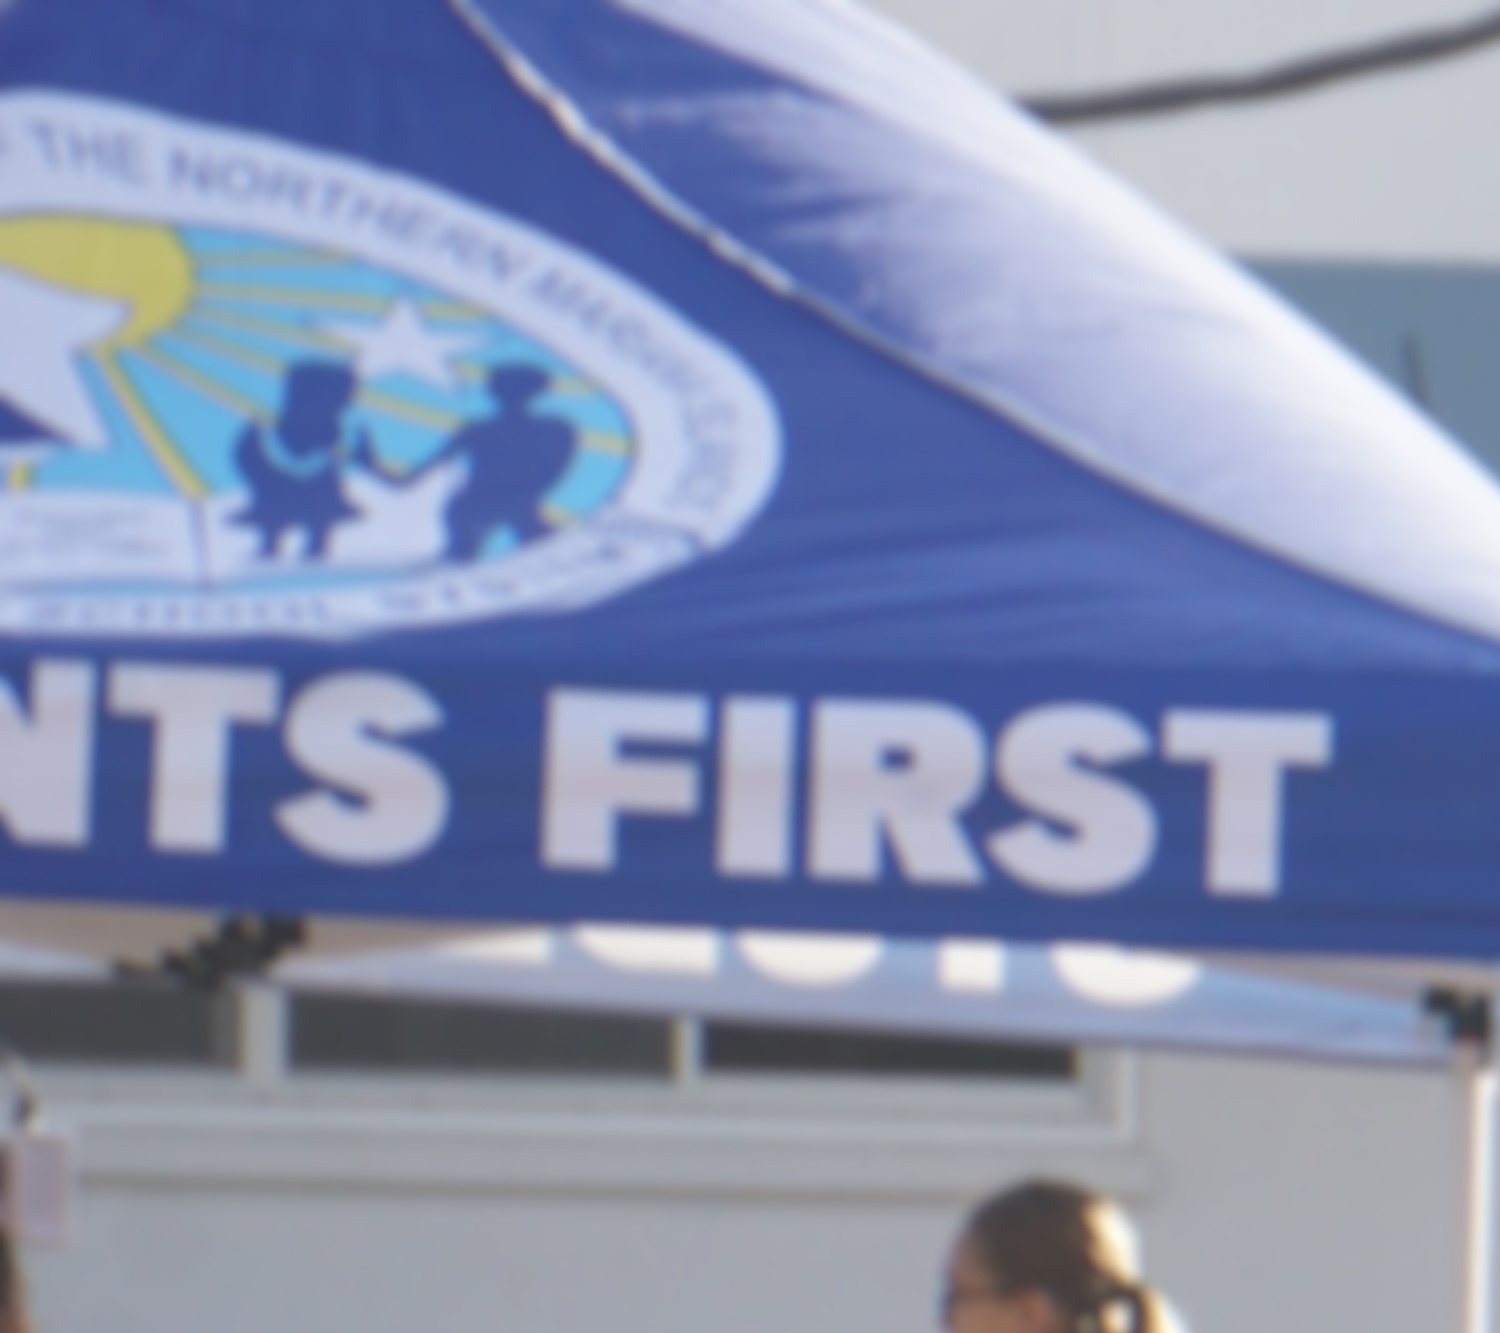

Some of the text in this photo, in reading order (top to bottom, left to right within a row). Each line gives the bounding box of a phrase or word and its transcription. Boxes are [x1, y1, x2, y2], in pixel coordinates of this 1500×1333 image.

[26, 119, 150, 189] THE
[170, 146, 528, 282] NORTHERN
[541, 686, 1335, 897] FIRST
